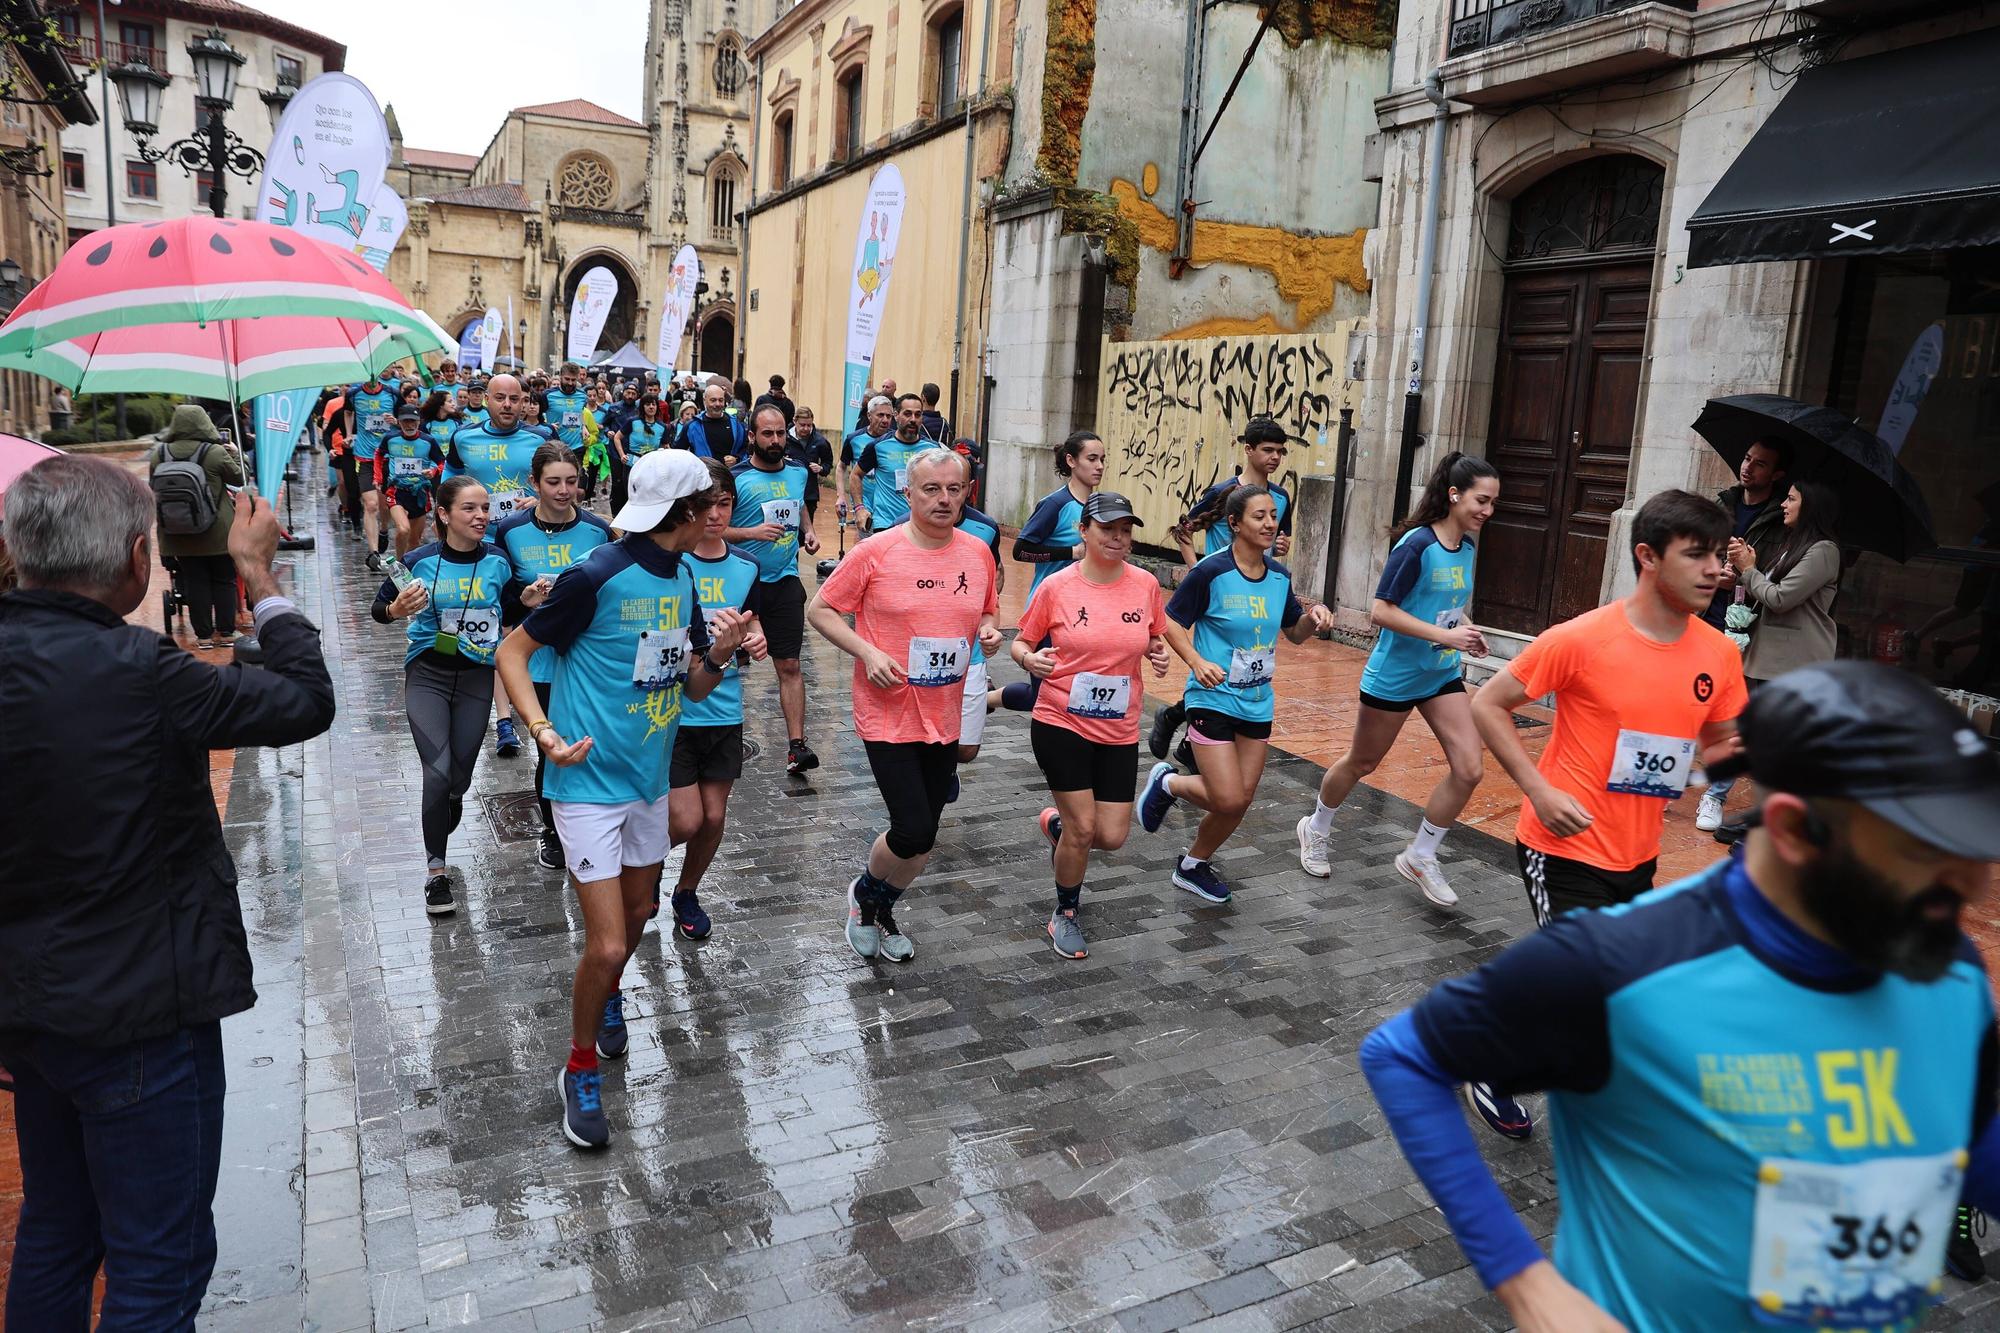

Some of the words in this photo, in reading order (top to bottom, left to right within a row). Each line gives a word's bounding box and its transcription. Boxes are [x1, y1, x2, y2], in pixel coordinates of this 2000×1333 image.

[1674, 264, 1684, 285] 5
[851, 382, 862, 402] 10
[266, 392, 292, 424] 10
[401, 445, 415, 458] 5K
[489, 444, 509, 461] 5K
[401, 463, 416, 471] 322
[770, 481, 789, 498] 5K
[499, 500, 513, 511] 88
[774, 508, 791, 520] 149
[547, 544, 573, 568] 5K
[1450, 566, 1466, 590] 5K
[458, 577, 486, 602] 5K
[699, 577, 727, 604] 5K
[658, 595, 681, 631] 5K
[1249, 595, 1269, 620] 5K
[456, 620, 489, 633] 300
[929, 652, 956, 667] 314
[1250, 659, 1264, 674] 93
[1090, 687, 1117, 702] 197
[1634, 751, 1676, 774] 360
[1816, 1048, 1915, 1149] 5K
